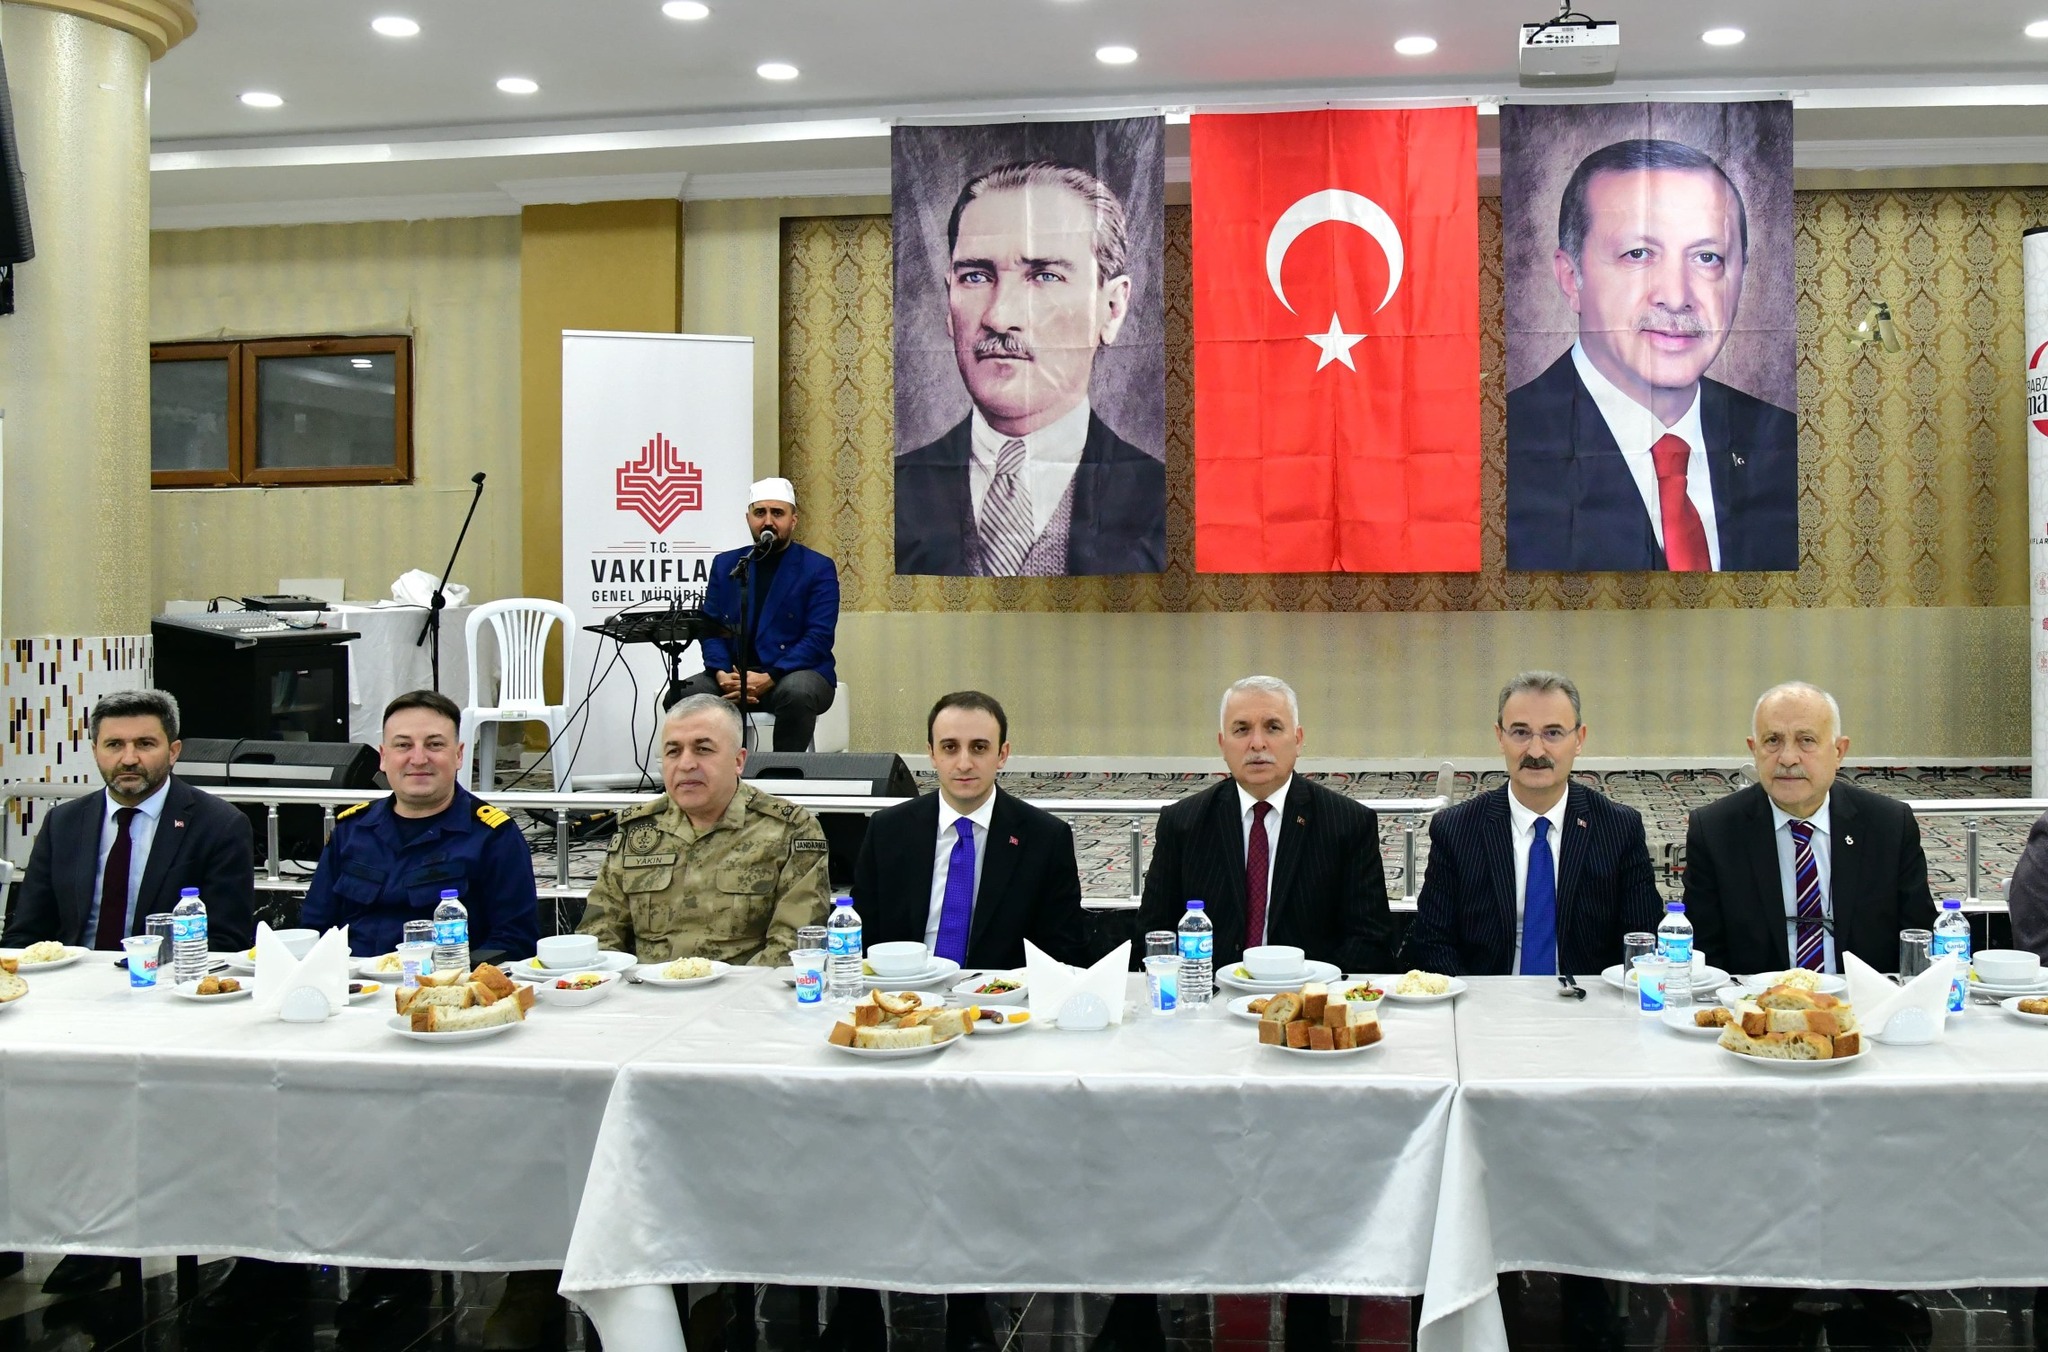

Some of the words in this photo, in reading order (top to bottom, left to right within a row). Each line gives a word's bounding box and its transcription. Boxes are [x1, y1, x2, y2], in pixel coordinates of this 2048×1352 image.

[650, 541, 670, 553] T.C.
[591, 559, 708, 583] VAKIFLA
[592, 590, 634, 602] GENEL
[641, 586, 708, 602] MÜDÜRLÜ
[796, 841, 826, 849] JANDARMA
[636, 857, 662, 865] YAKIN
